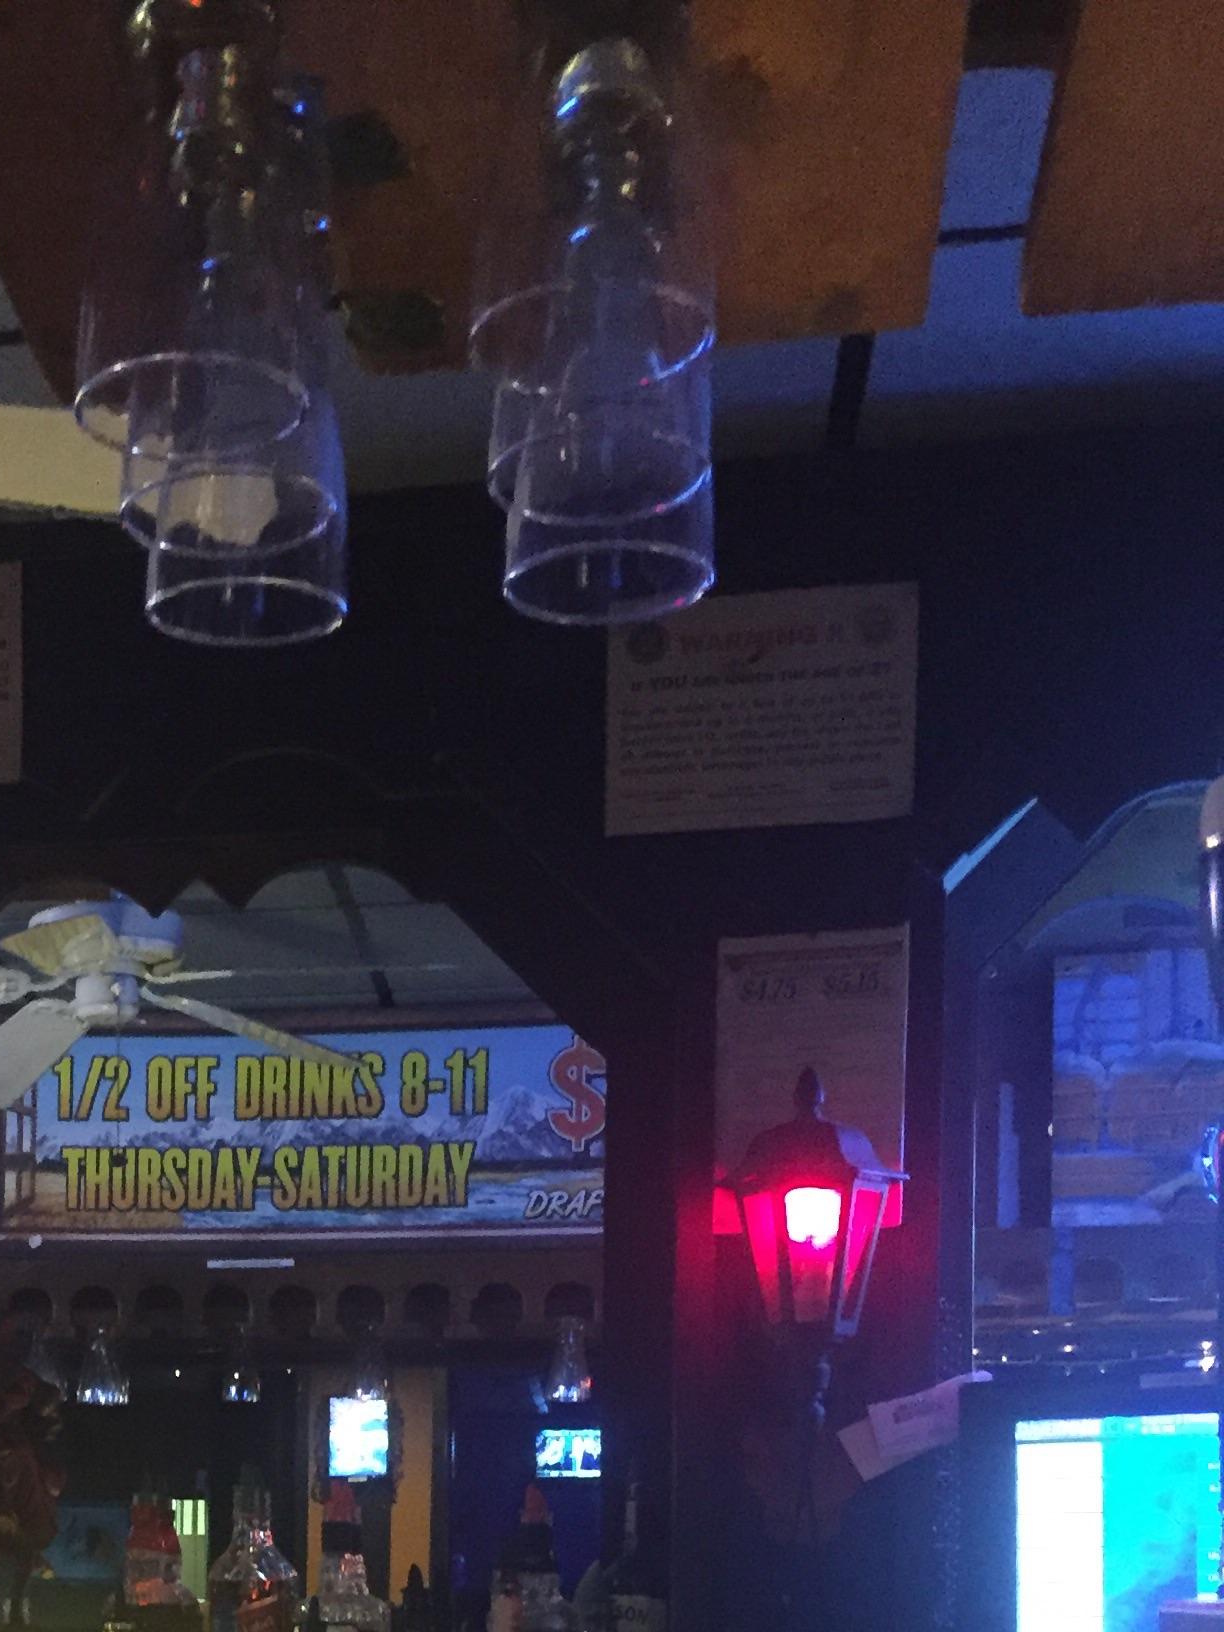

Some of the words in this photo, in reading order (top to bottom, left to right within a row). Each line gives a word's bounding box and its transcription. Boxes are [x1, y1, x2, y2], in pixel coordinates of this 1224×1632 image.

[54, 1054, 131, 1122] 1/2
[145, 1056, 221, 1122] OFF
[234, 1050, 384, 1121] DRINKS
[399, 1047, 490, 1117] 8-11
[524, 1189, 604, 1219] DRAF
